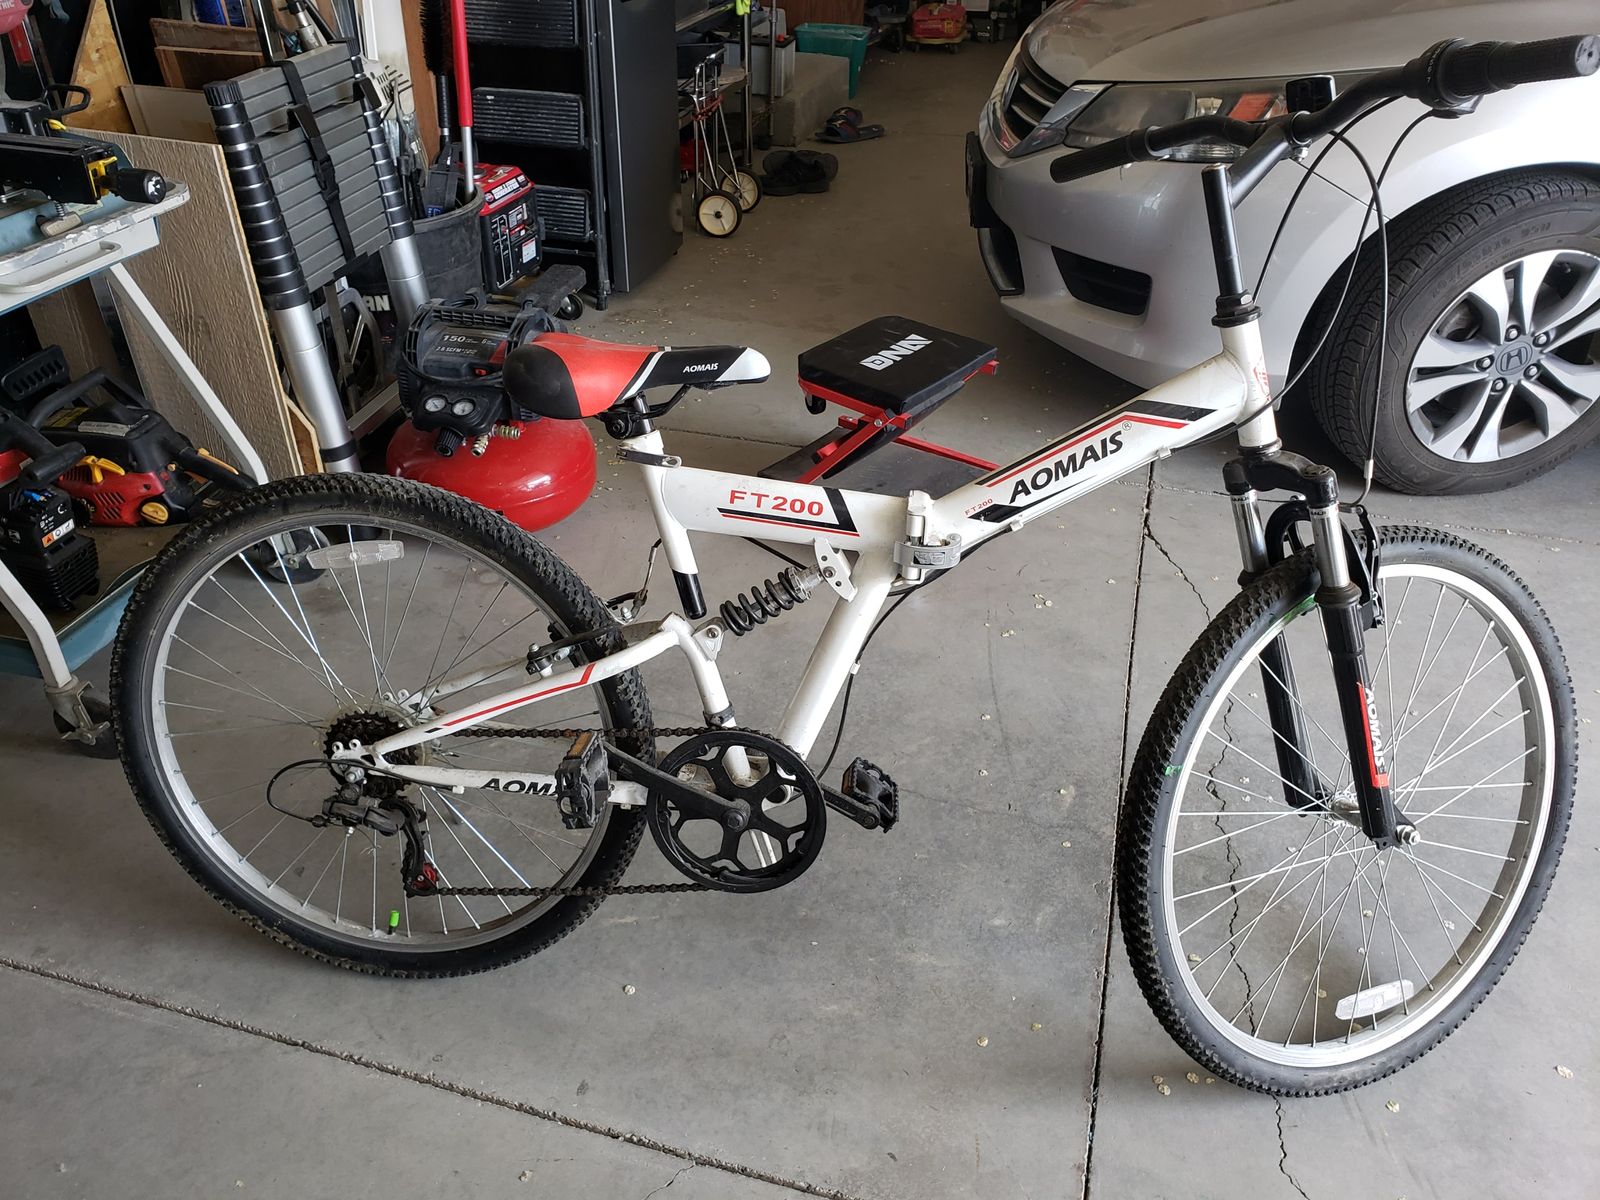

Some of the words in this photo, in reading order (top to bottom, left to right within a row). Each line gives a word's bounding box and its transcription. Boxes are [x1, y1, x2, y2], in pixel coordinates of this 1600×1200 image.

[443, 335, 466, 343] 150
[859, 333, 934, 371] DNA
[683, 362, 719, 373] AOMAIS
[729, 489, 824, 517] FT200
[964, 498, 993, 516] FT200
[480, 777, 559, 797] AOM
